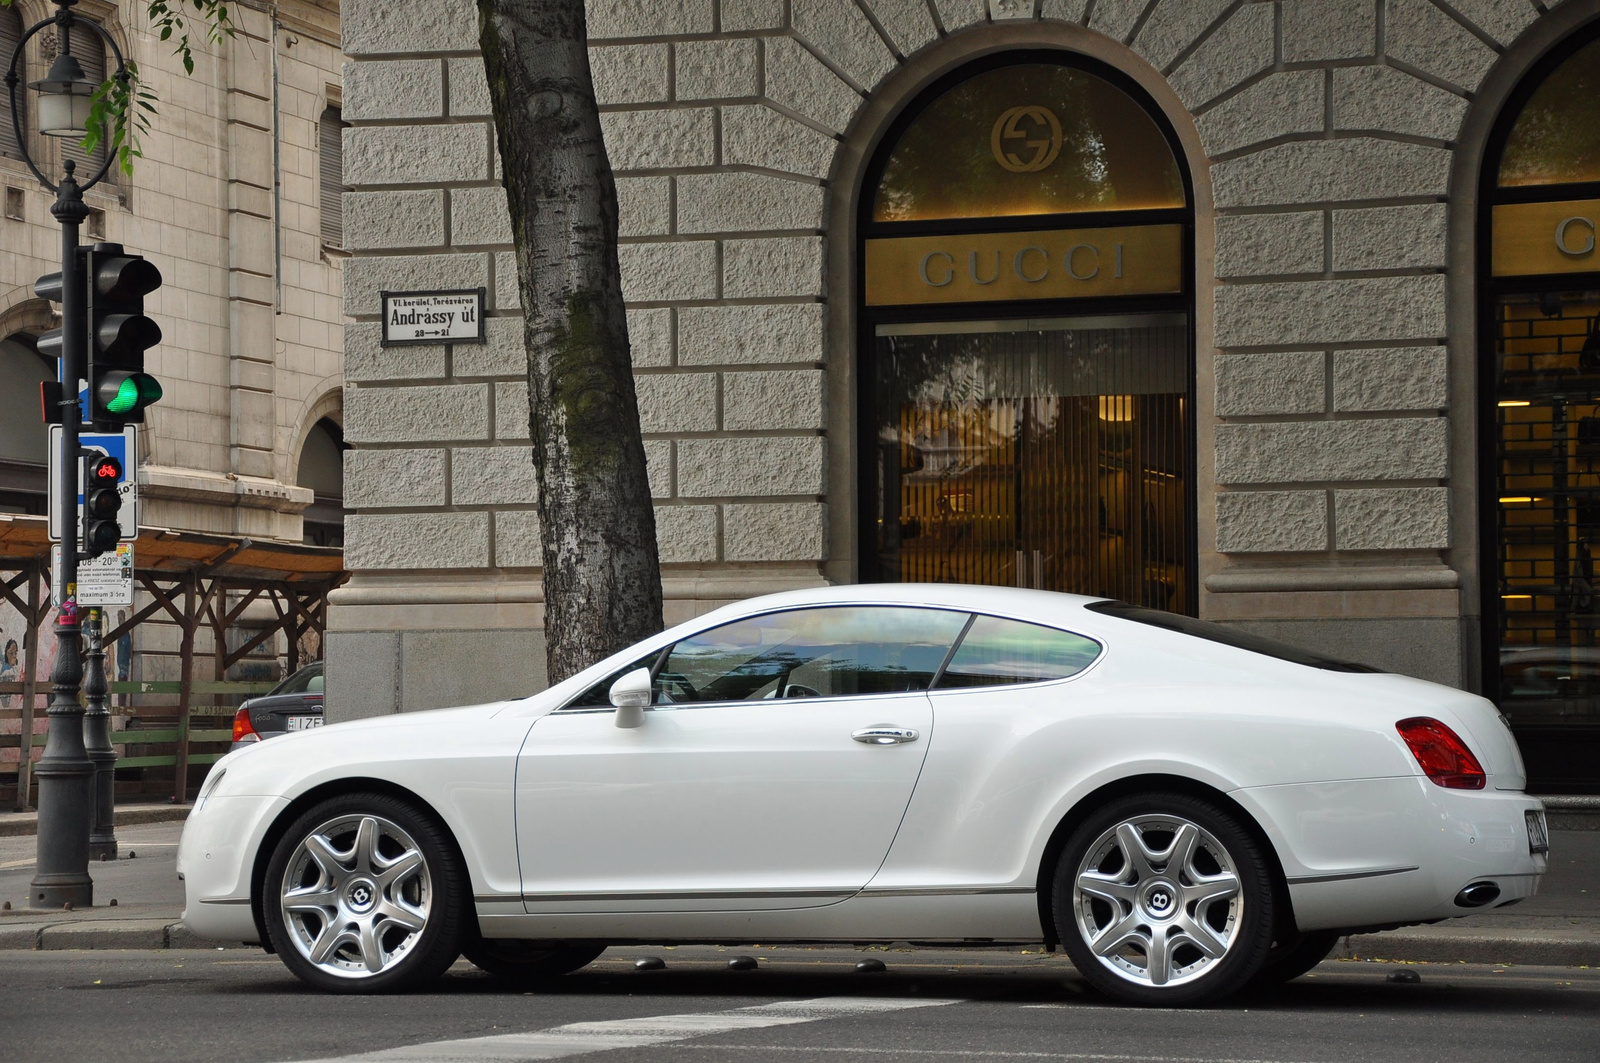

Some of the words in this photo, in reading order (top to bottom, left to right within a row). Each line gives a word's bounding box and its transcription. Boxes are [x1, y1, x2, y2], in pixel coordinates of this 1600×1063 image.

[919, 244, 1123, 287] GUCCI
[390, 307, 455, 329] Andrássy
[462, 306, 475, 323] út
